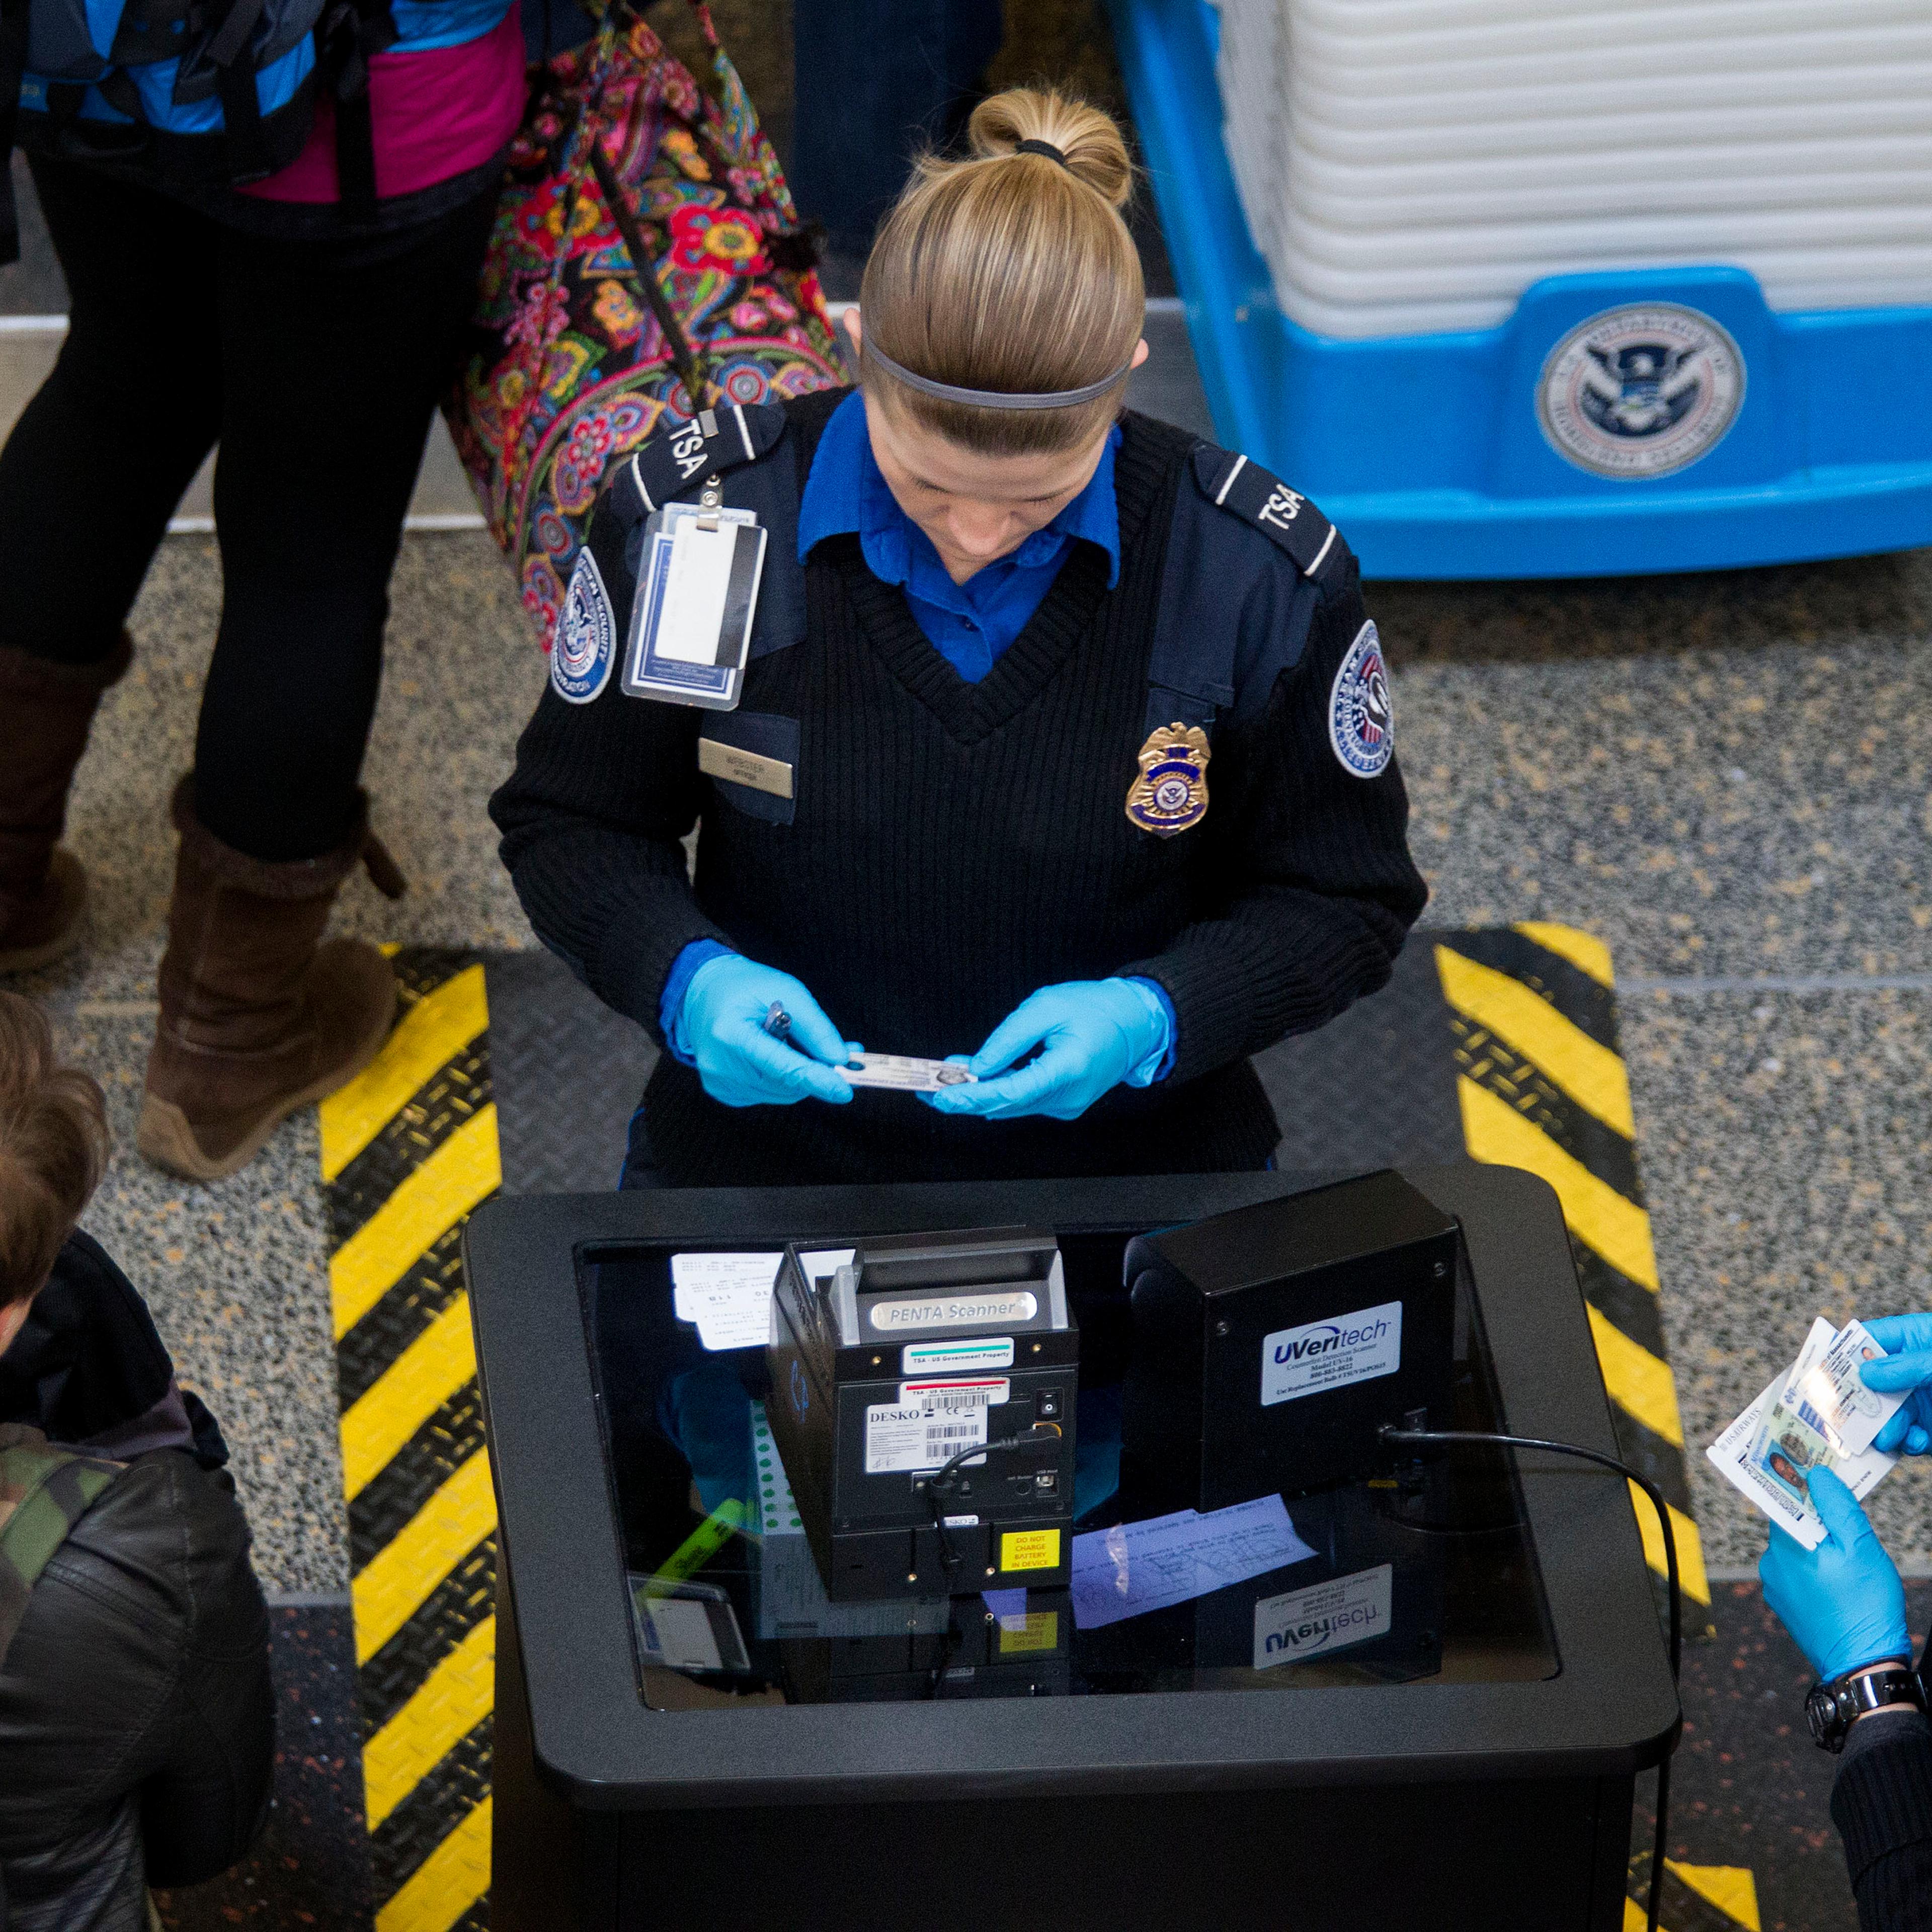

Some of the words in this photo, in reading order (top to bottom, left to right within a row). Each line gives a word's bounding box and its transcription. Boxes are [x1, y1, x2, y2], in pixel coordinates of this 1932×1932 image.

[669, 419, 708, 479] TSA
[1258, 484, 1305, 529] TSA
[890, 1307, 943, 1323] PENTA
[949, 1302, 1016, 1318] Scanner
[1274, 1319, 1388, 1364] UVeritech
[942, 1353, 981, 1361] Government
[982, 1351, 1009, 1360] Property
[870, 1410, 920, 1423] DESKO
[1014, 1552, 1047, 1560] BATTERY
[1015, 1544, 1046, 1552] CHARGE
